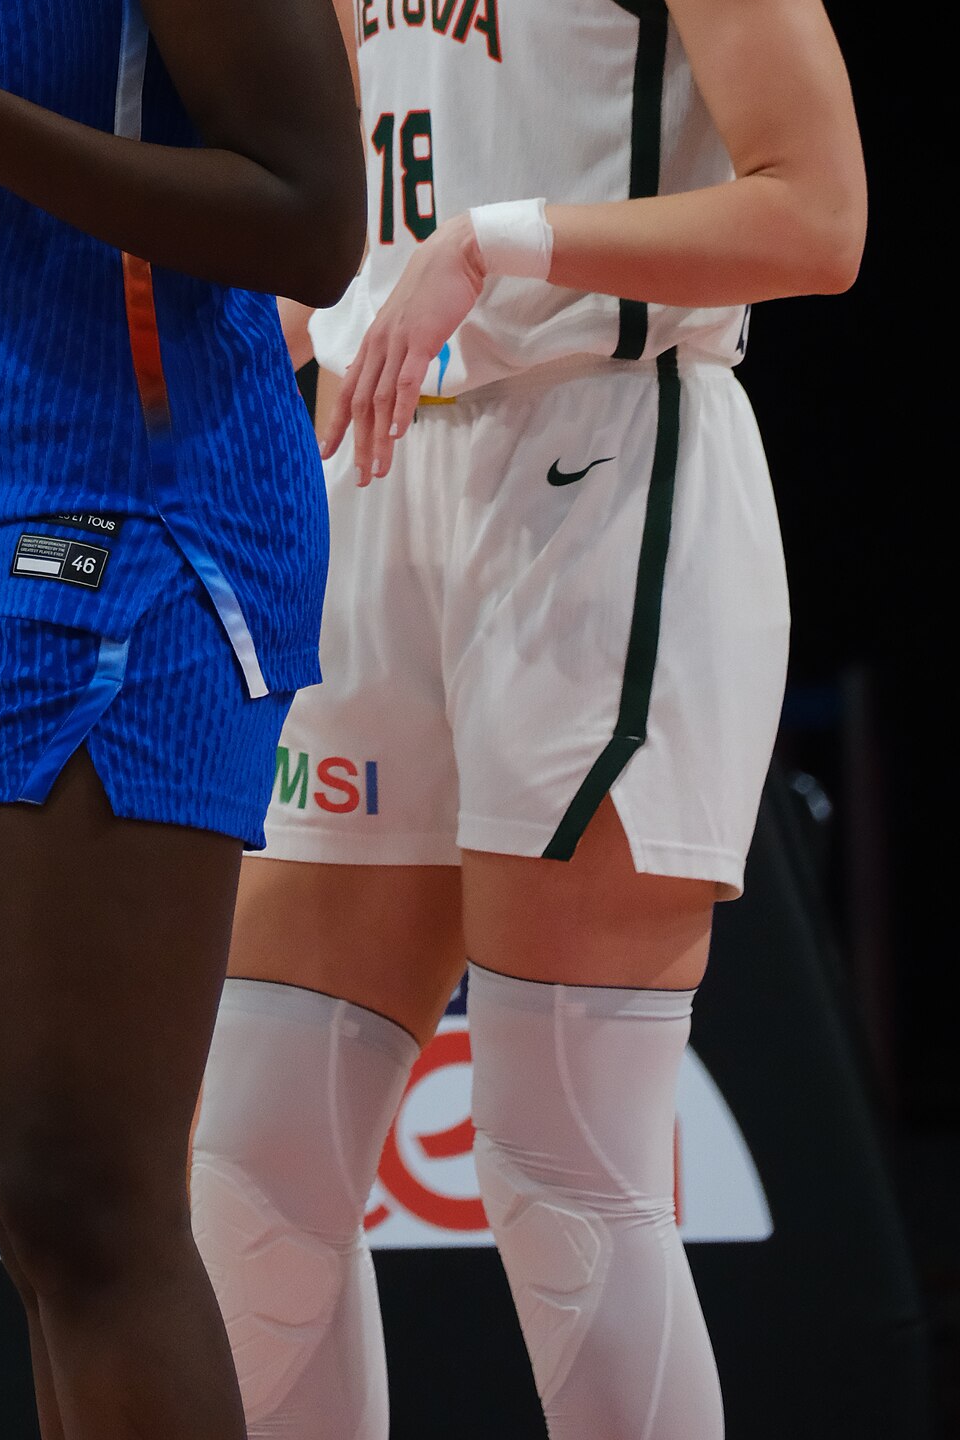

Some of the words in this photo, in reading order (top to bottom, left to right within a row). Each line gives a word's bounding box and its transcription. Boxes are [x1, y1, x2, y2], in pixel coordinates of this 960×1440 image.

[371, 109, 438, 245] 18
[87, 515, 116, 531] TOUS
[71, 554, 97, 574] 46
[274, 745, 379, 816] MSI
